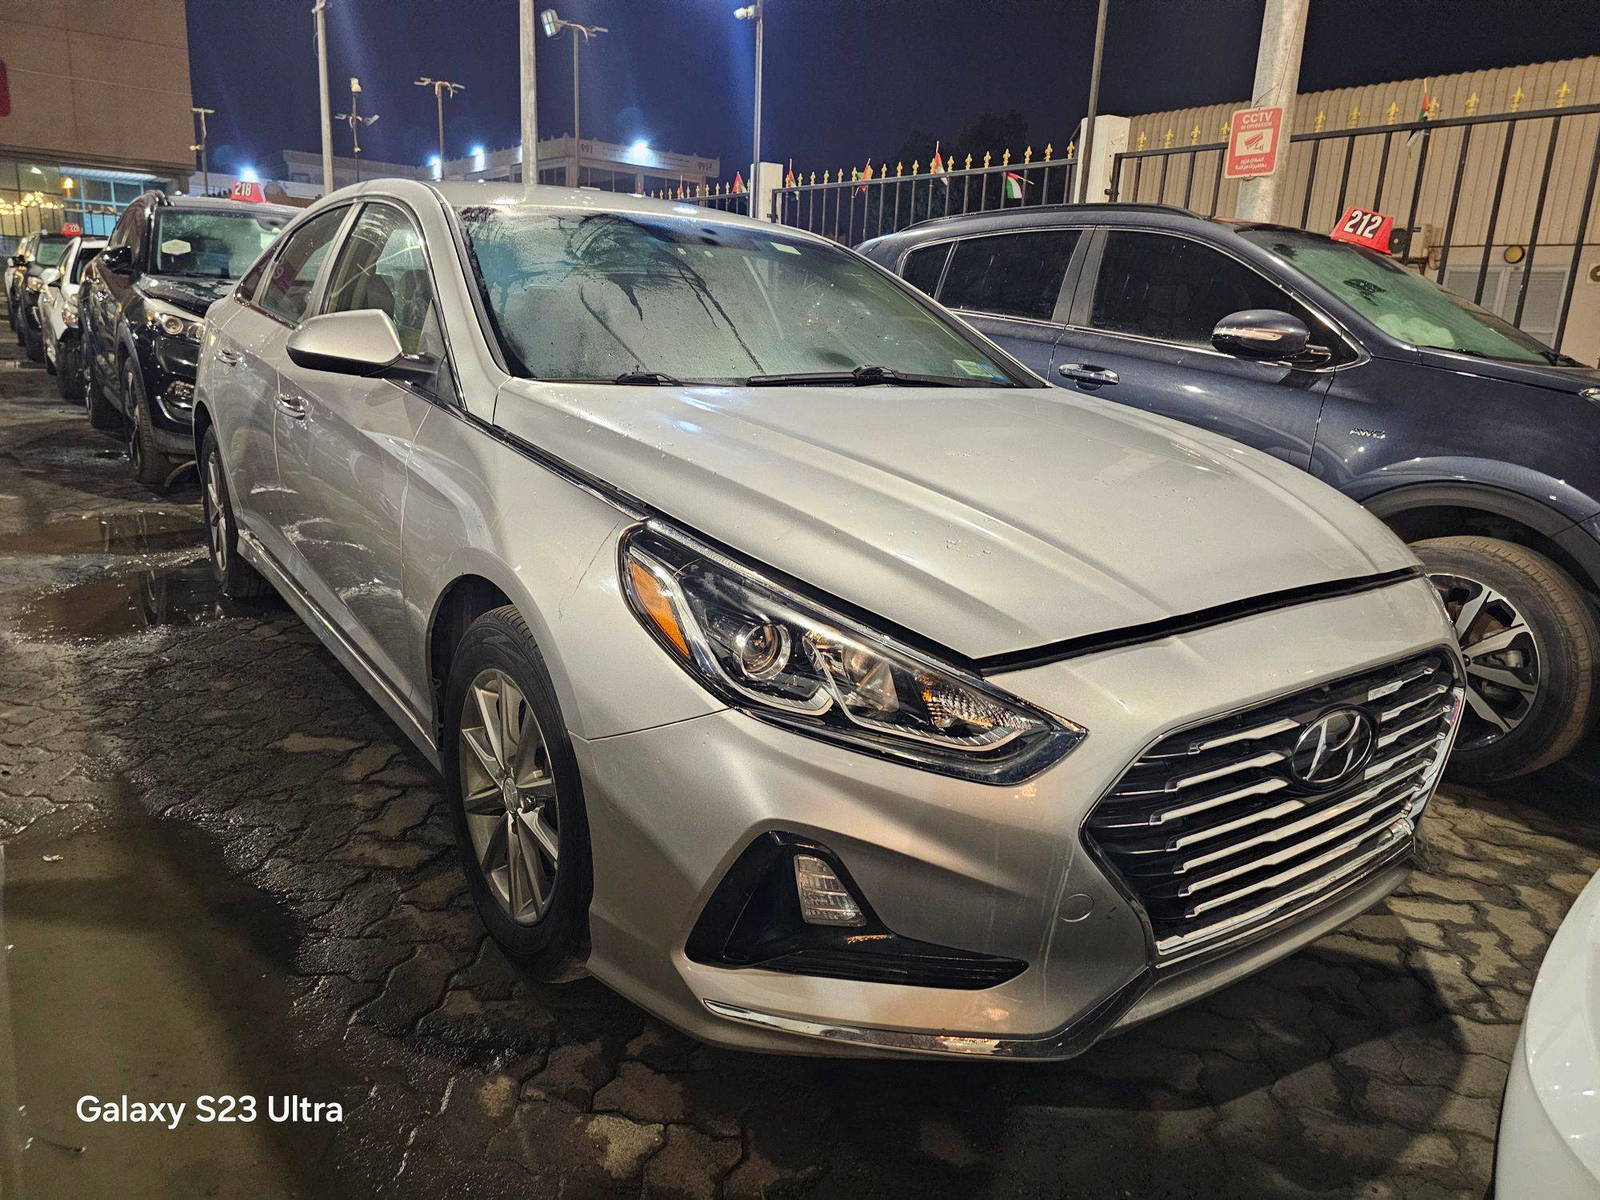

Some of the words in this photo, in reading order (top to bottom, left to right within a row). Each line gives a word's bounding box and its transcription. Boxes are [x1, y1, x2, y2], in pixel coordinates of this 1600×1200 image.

[1242, 111, 1273, 124] CCTV
[235, 182, 252, 197] 218
[1343, 210, 1383, 239] 212
